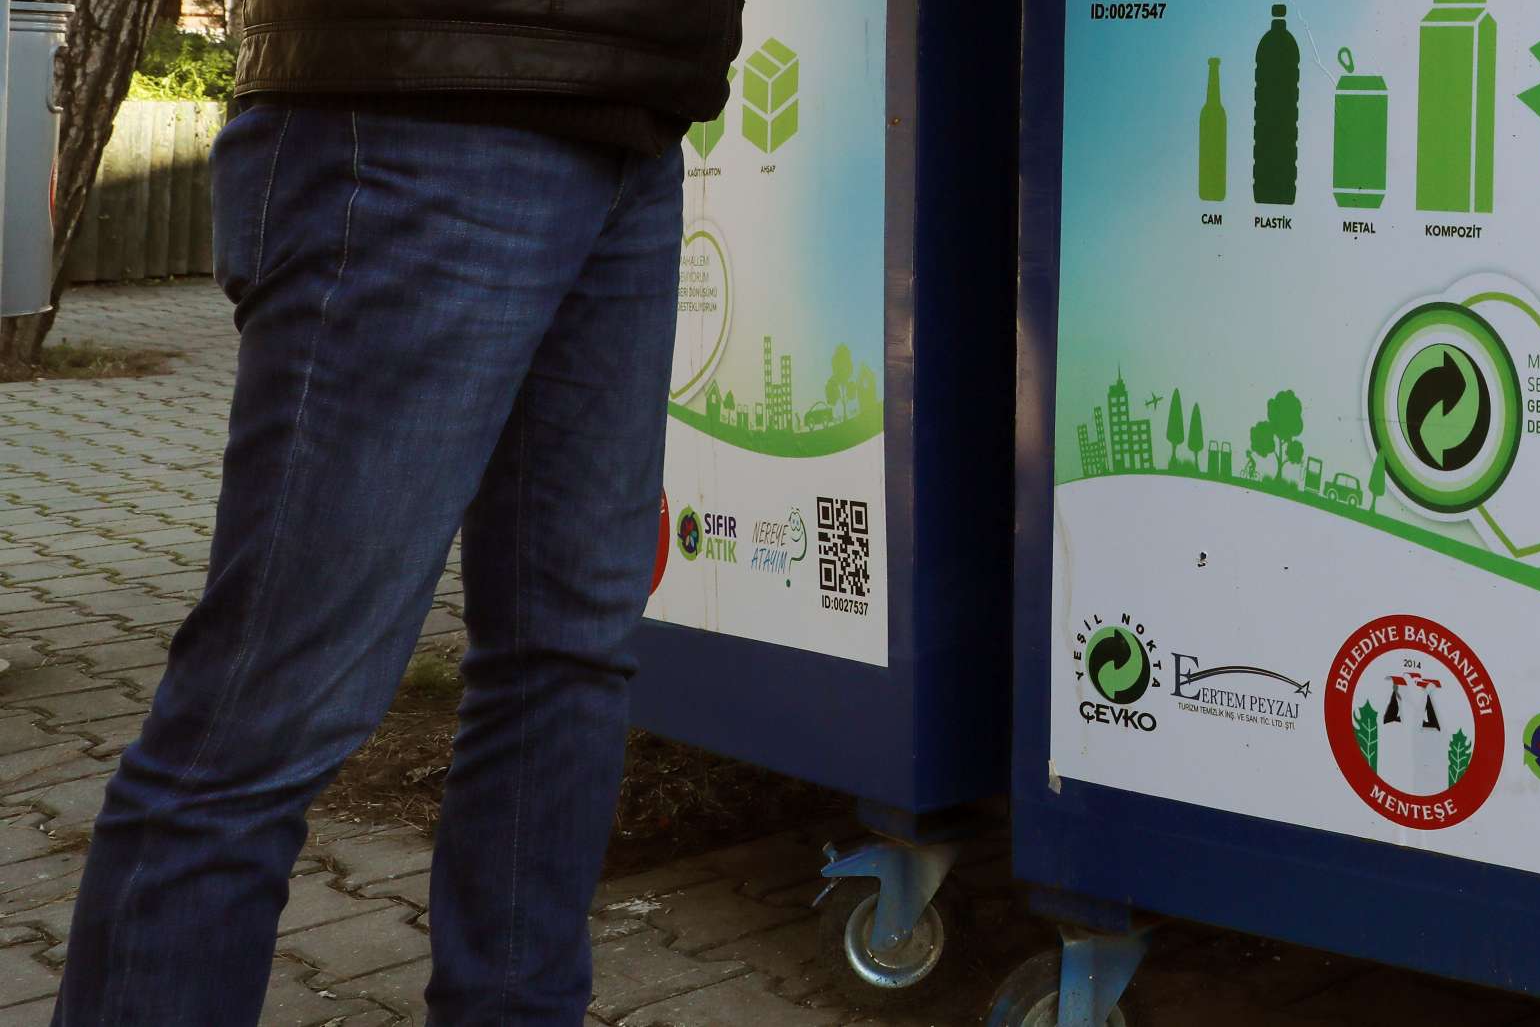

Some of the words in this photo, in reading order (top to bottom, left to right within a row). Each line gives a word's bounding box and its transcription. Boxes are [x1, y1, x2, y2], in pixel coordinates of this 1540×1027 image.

[1090, 3, 1167, 20] ID:0027547
[1201, 213, 1223, 226] CAM
[1254, 215, 1292, 230] PLASTİK
[1342, 221, 1376, 234] METAL
[1425, 224, 1483, 239] KOMPOZİT
[704, 513, 737, 539] SIFIR
[752, 521, 789, 547] NEREYE
[705, 538, 738, 564] ATIK
[751, 547, 788, 574] ATAYIM
[821, 595, 869, 617] ID:0027537
[1121, 613, 1161, 688] NOKTA
[1335, 626, 1400, 694] BELEDİYE
[1403, 625, 1493, 717] BAŞKANLIĞI
[1403, 659, 1422, 671] 2014
[1079, 701, 1157, 732] ÇEVKO
[1249, 695, 1300, 719] PEYZAJ
[1369, 784, 1459, 823] MENTEŞE
